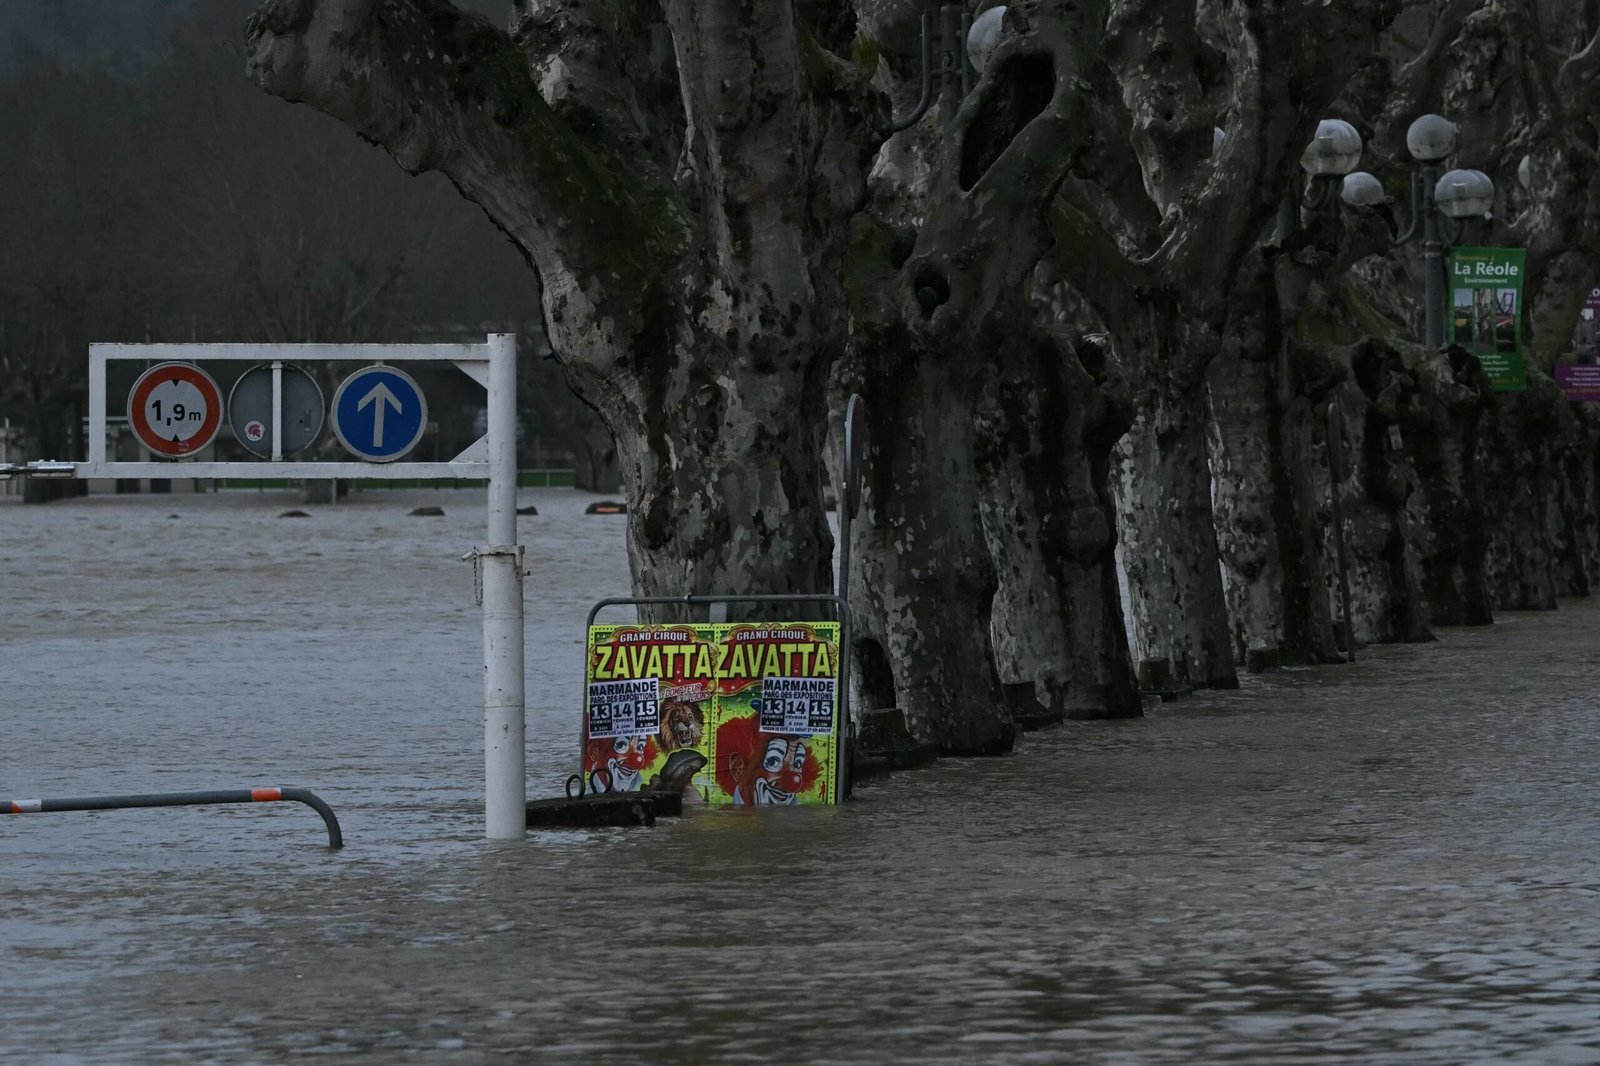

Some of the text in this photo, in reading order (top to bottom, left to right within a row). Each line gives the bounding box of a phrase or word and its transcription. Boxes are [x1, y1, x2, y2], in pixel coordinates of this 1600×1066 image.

[1455, 261, 1519, 276] La Réole
[152, 399, 201, 426] 1,9 m
[620, 631, 688, 643] GRAND CIRQUE
[736, 630, 807, 641] GRAND CIRQUE
[595, 644, 713, 679] ZAVATTA
[716, 643, 831, 678] ZAVATTA
[589, 681, 657, 696] MARMANDE
[763, 679, 834, 692] MARMANDE
[590, 692, 657, 704] PARC DES EXPOSITIONS
[764, 690, 833, 700] PARC DES EXPOSITIONS
[591, 701, 656, 720] 13 14 15
[764, 699, 831, 716] 13 14 15
